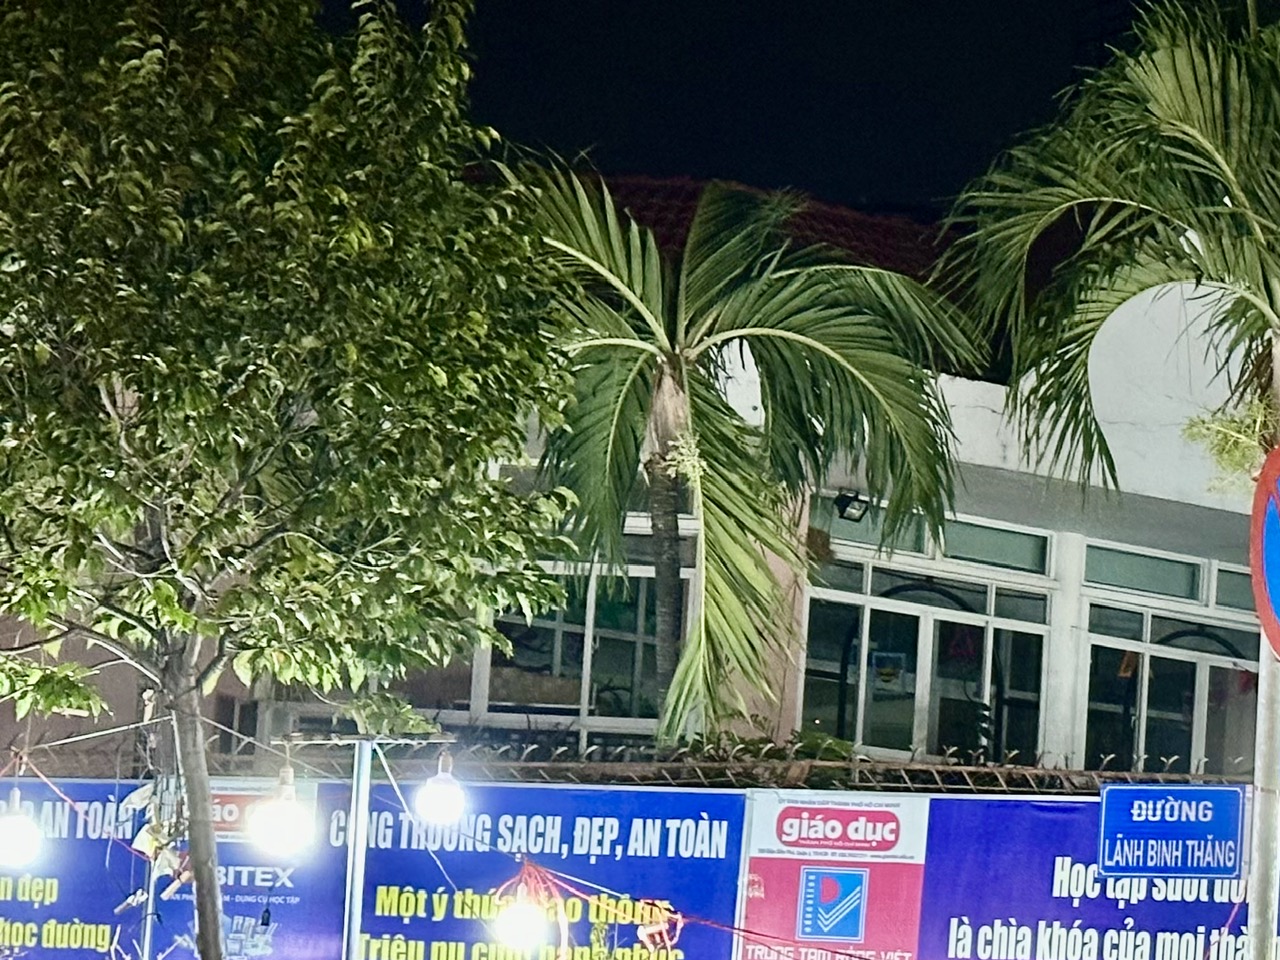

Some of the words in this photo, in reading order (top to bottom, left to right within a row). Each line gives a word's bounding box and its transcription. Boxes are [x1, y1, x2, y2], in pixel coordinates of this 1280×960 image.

[1131, 796, 1213, 822] ĐƯỜNG
[573, 816, 624, 864] ĐẸP,
[627, 818, 661, 857] AN
[666, 812, 728, 859] TOÀN
[781, 811, 843, 842] giáo
[847, 816, 896, 847] dục
[1104, 833, 1144, 867] LÃNH
[1147, 839, 1182, 868] BINH
[1185, 834, 1235, 868] THĂNG
[1052, 856, 1102, 907] Học
[375, 886, 427, 924] Một
[432, 887, 448, 921] ý
[41, 918, 111, 953] đường
[949, 917, 970, 959] là
